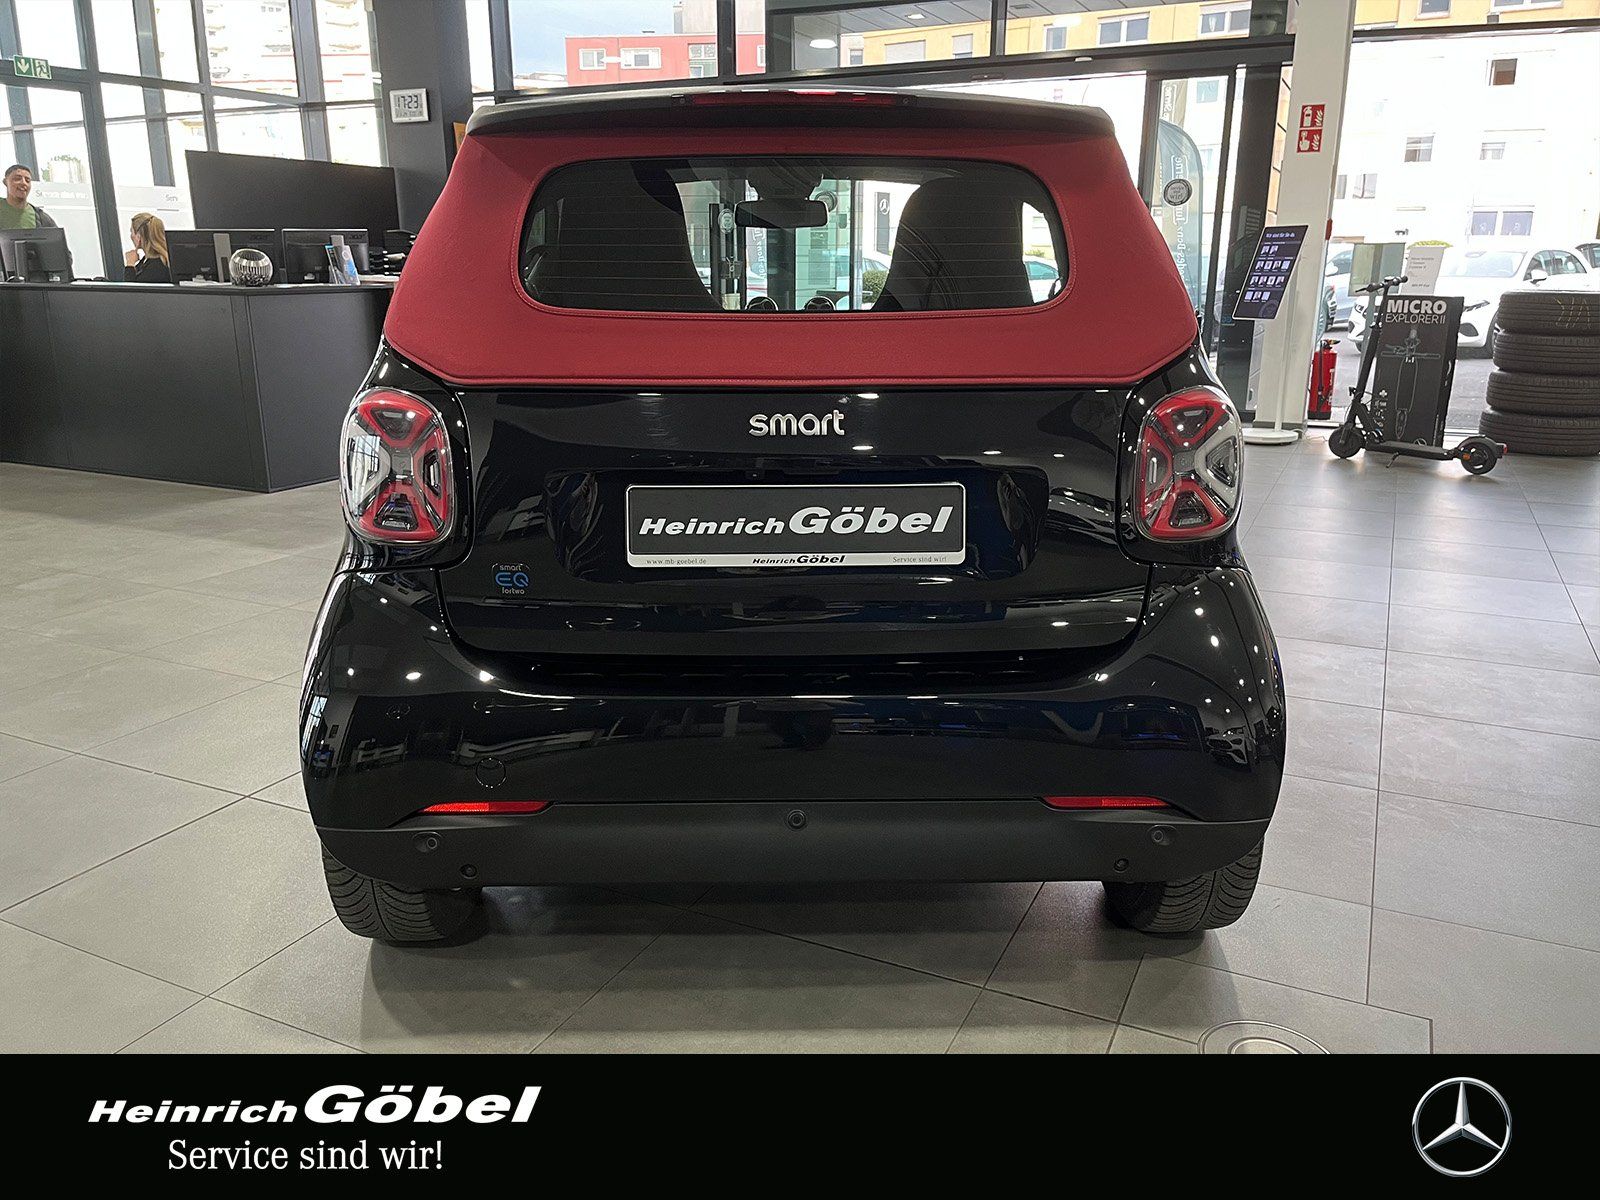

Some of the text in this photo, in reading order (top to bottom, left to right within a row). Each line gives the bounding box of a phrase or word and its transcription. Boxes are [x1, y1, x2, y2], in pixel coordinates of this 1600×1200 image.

[1386, 300, 1447, 315] MICRO
[1385, 313, 1438, 324] EXPLORER
[749, 409, 845, 436] smart
[638, 507, 953, 536] Heinrich Göbel
[752, 557, 796, 565] Heinrich
[796, 554, 846, 564] Göbel
[892, 556, 917, 564] Service
[918, 555, 932, 563] sind
[495, 571, 529, 588] EQ
